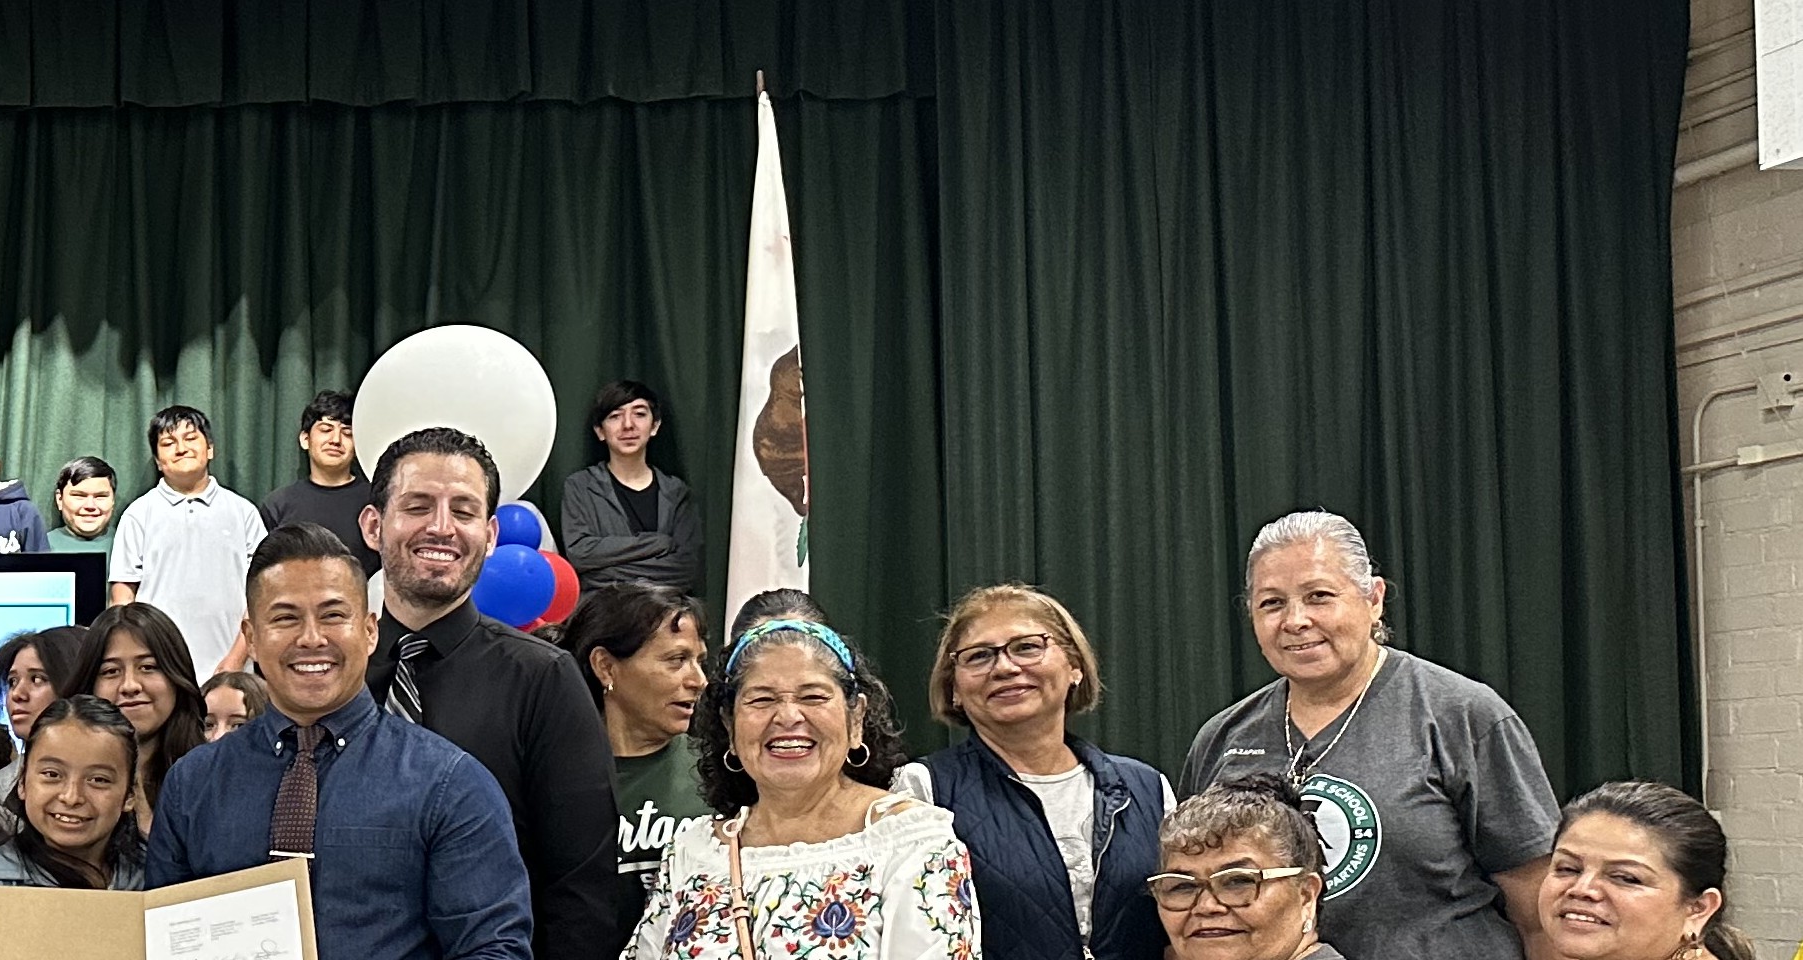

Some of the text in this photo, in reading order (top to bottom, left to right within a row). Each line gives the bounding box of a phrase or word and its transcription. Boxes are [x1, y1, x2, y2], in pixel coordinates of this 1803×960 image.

[1326, 784, 1369, 826] SCHOOL
[1354, 828, 1373, 839] 54
[1325, 843, 1369, 890] PARTANS
